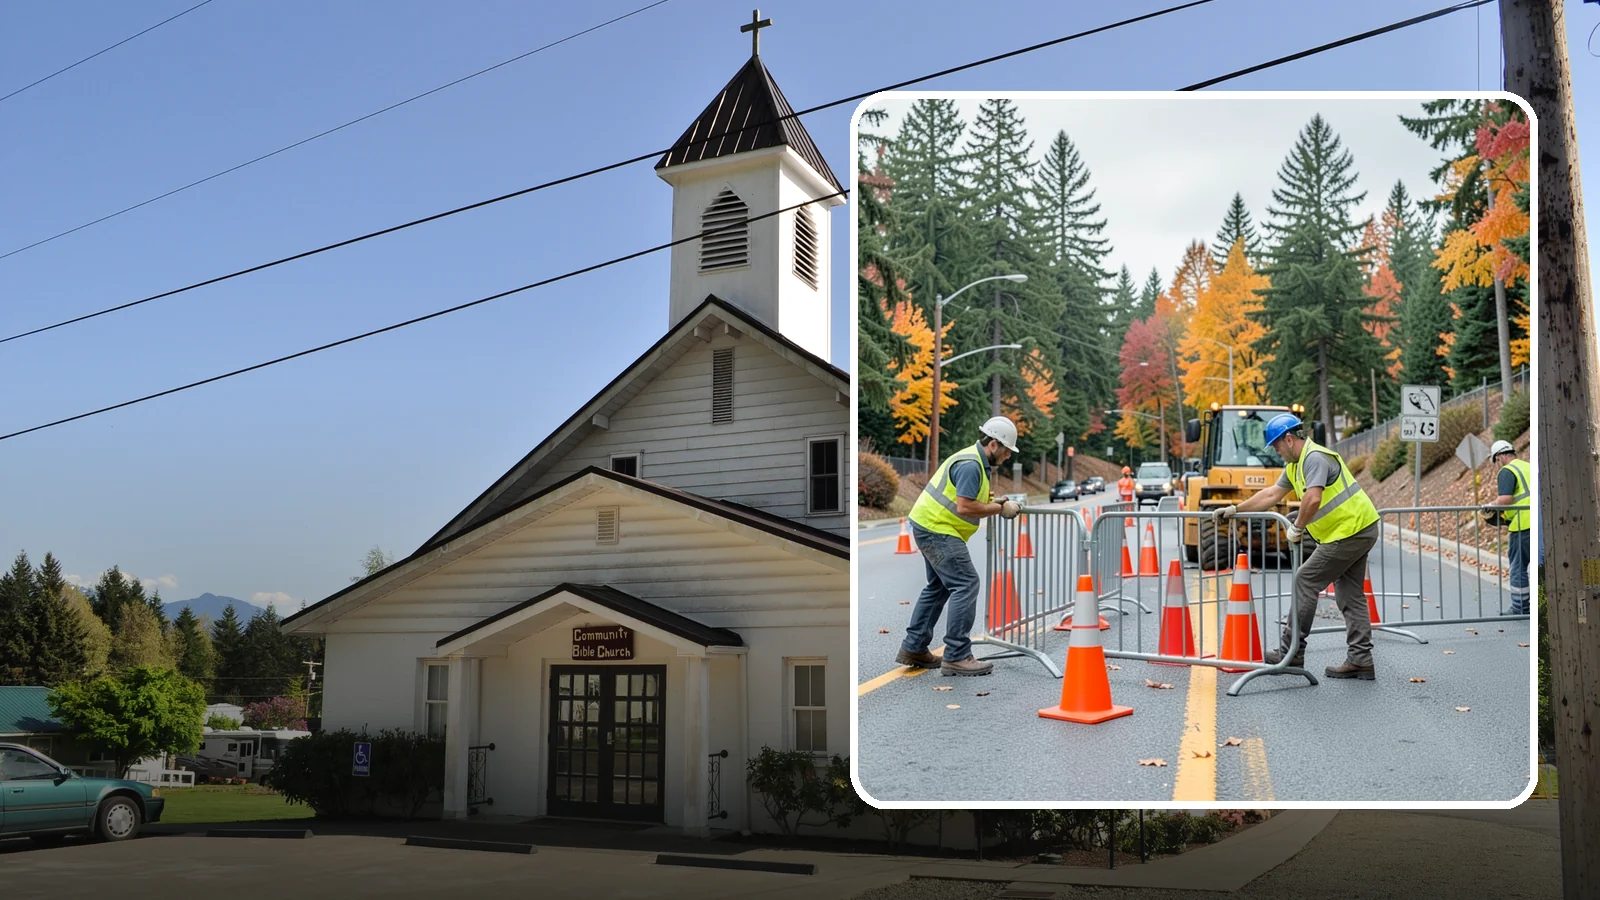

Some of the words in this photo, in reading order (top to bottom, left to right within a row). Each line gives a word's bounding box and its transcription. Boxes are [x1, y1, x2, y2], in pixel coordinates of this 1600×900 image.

[574, 627, 628, 641] Community
[572, 645, 595, 657] Bible
[597, 645, 631, 658] Church
